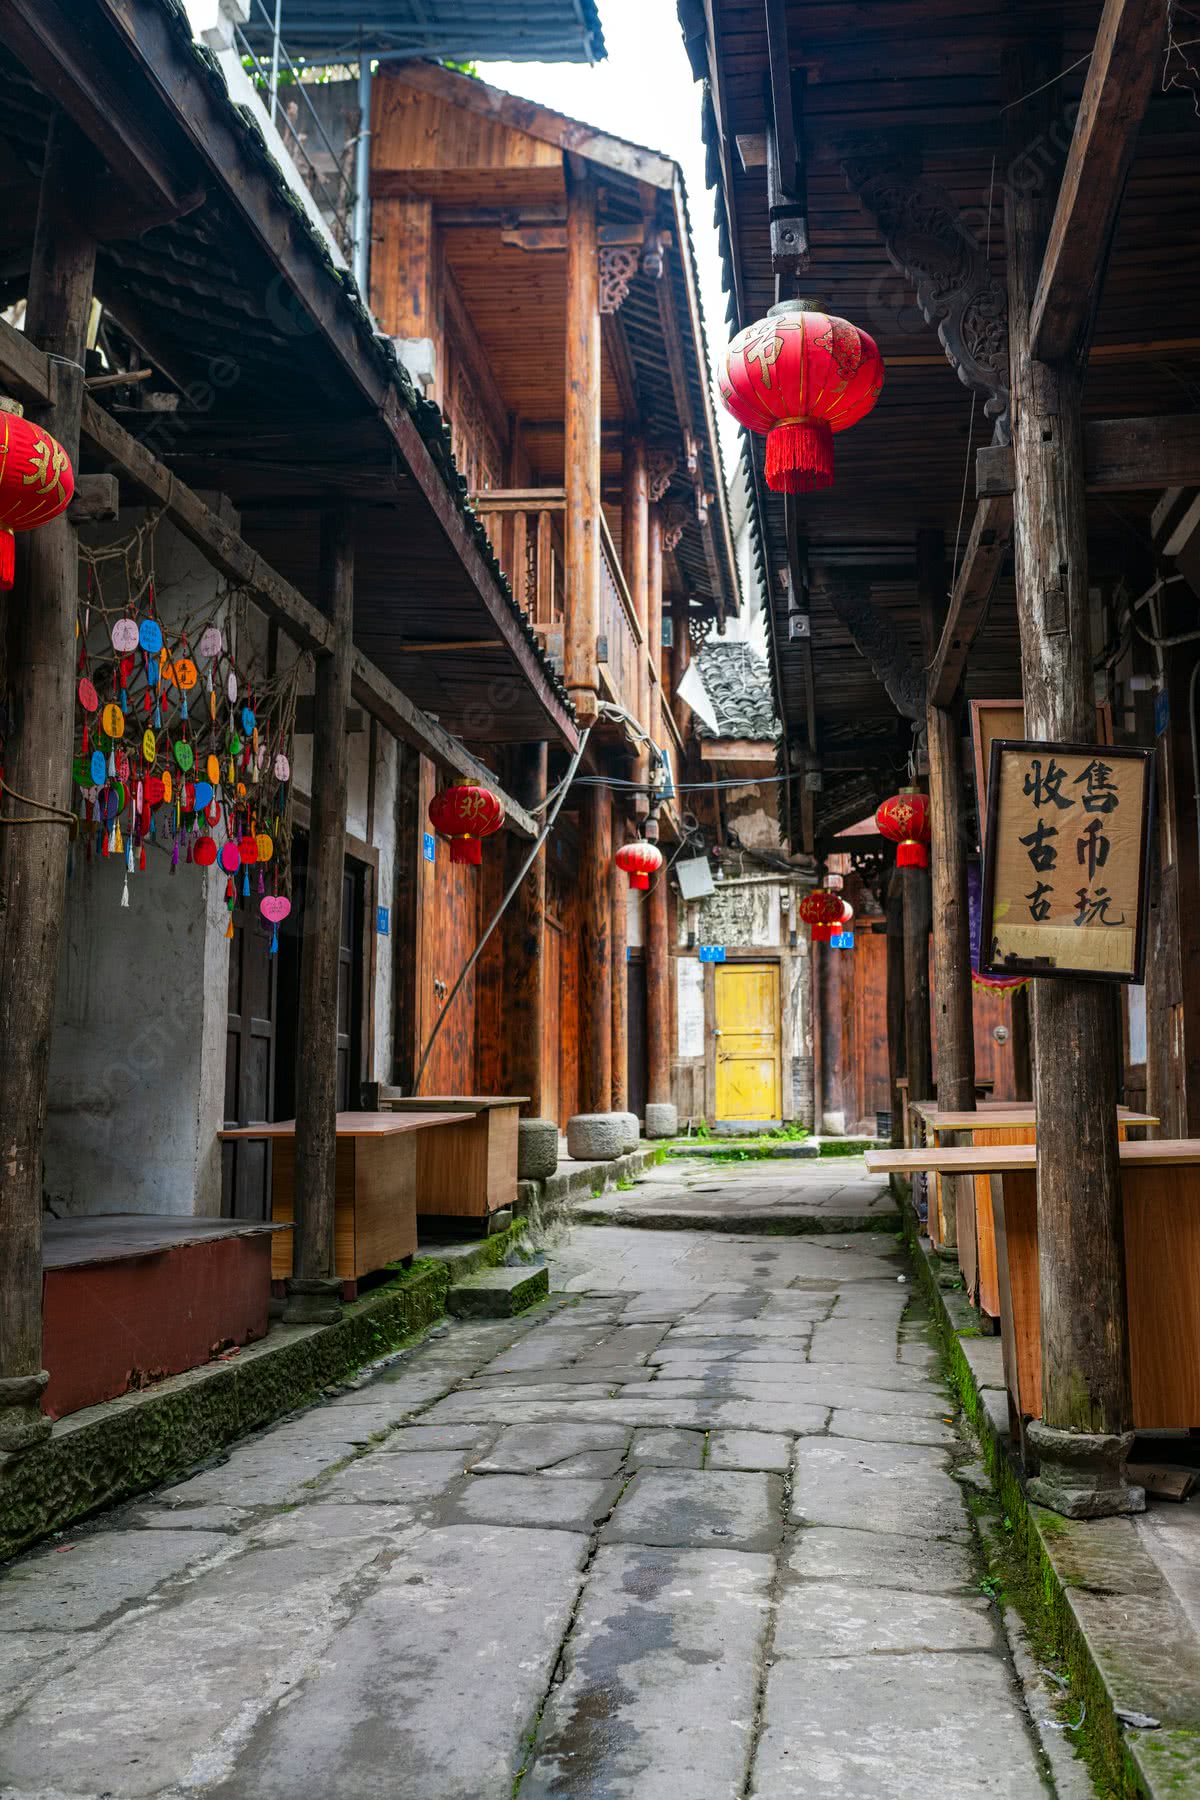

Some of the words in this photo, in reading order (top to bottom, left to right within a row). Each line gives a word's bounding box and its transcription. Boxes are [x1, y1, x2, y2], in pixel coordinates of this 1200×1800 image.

[1022, 758, 1119, 814] 收售
[1018, 818, 1111, 882] 古币
[1024, 880, 1125, 927] 古玩
